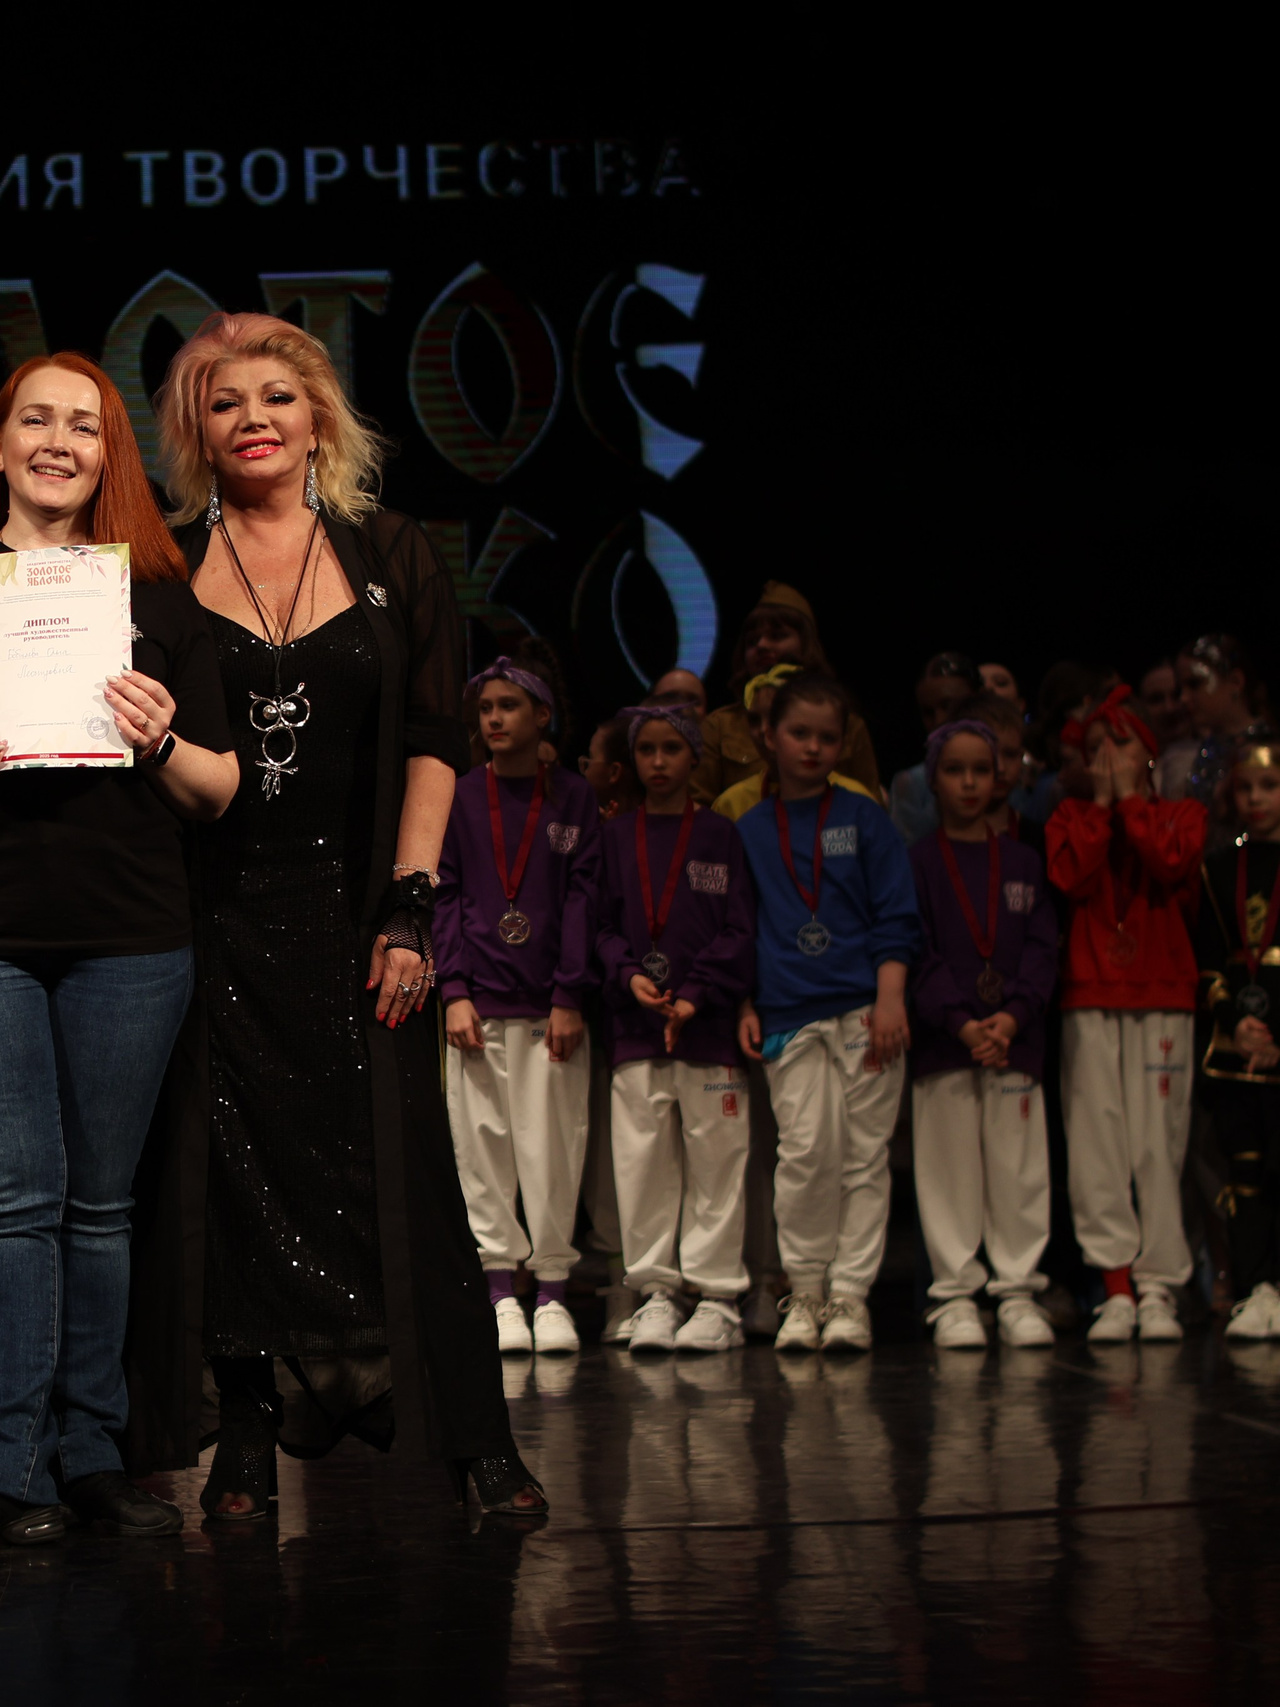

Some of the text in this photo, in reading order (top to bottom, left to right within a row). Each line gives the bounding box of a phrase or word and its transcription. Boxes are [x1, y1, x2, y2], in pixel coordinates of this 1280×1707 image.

[122, 138, 704, 208] ТВОРЧЕСТВА
[27, 574, 71, 587] ЯБЛОЧКО
[23, 617, 70, 628] ДИПЛОМ
[688, 862, 726, 878] CREATE
[691, 876, 727, 892] TODAY!
